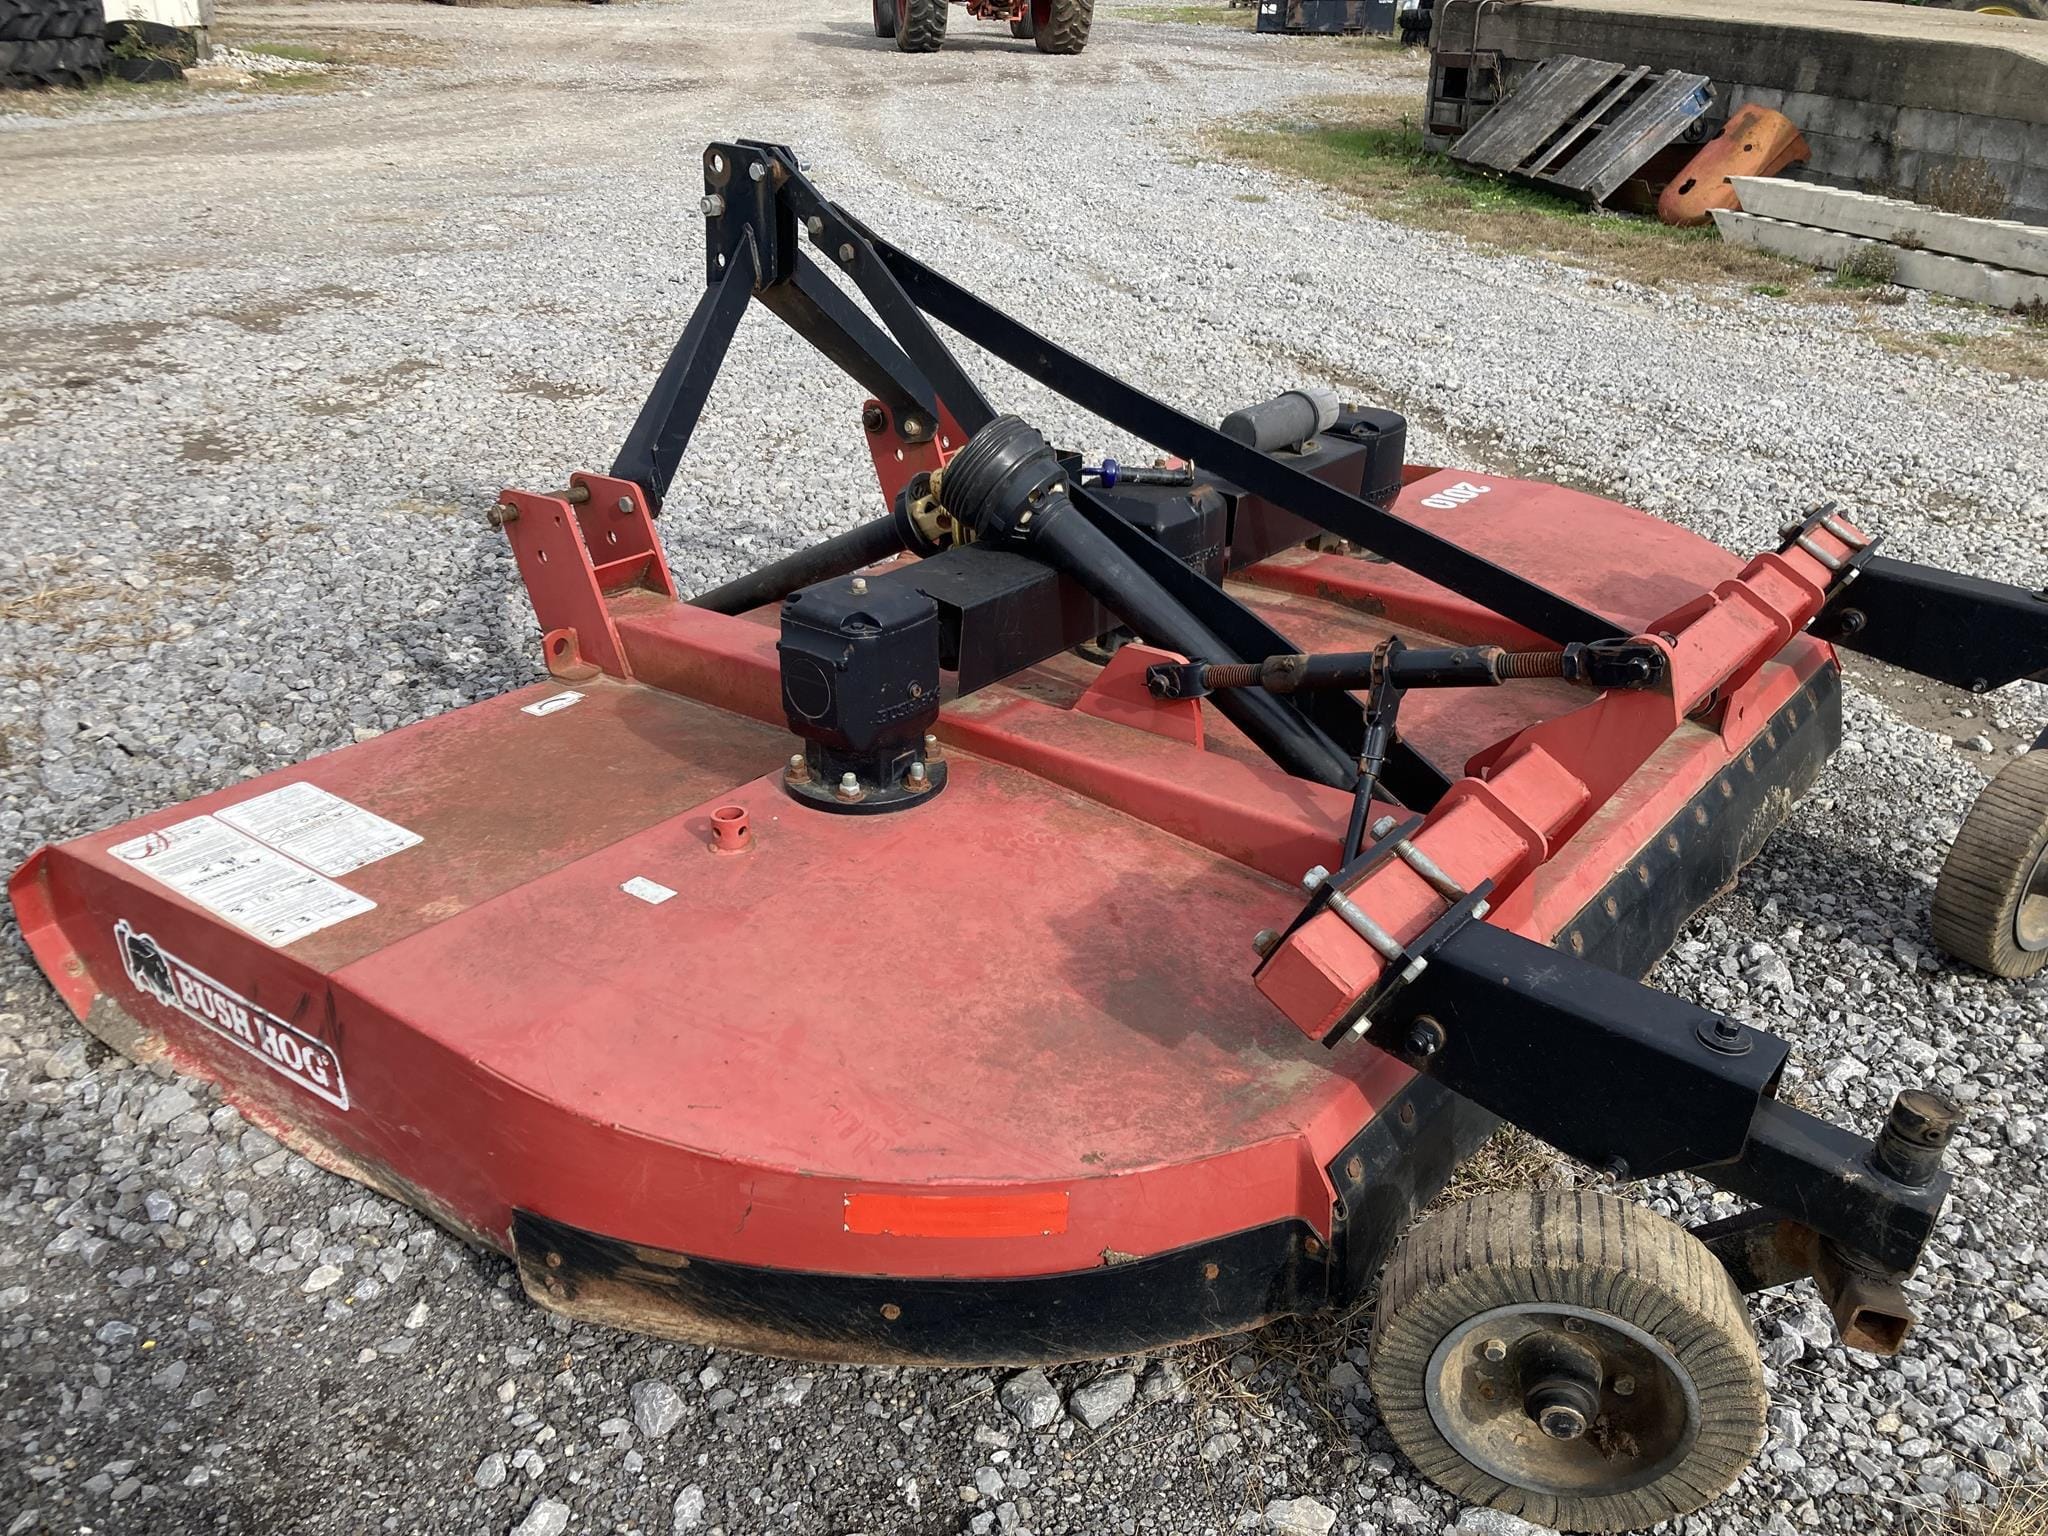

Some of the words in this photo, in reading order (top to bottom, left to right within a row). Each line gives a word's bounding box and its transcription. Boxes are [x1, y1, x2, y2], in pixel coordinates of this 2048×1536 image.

[1420, 481, 1492, 509] 2010
[175, 969, 255, 1044] BUSH
[253, 1016, 330, 1088] HOG
